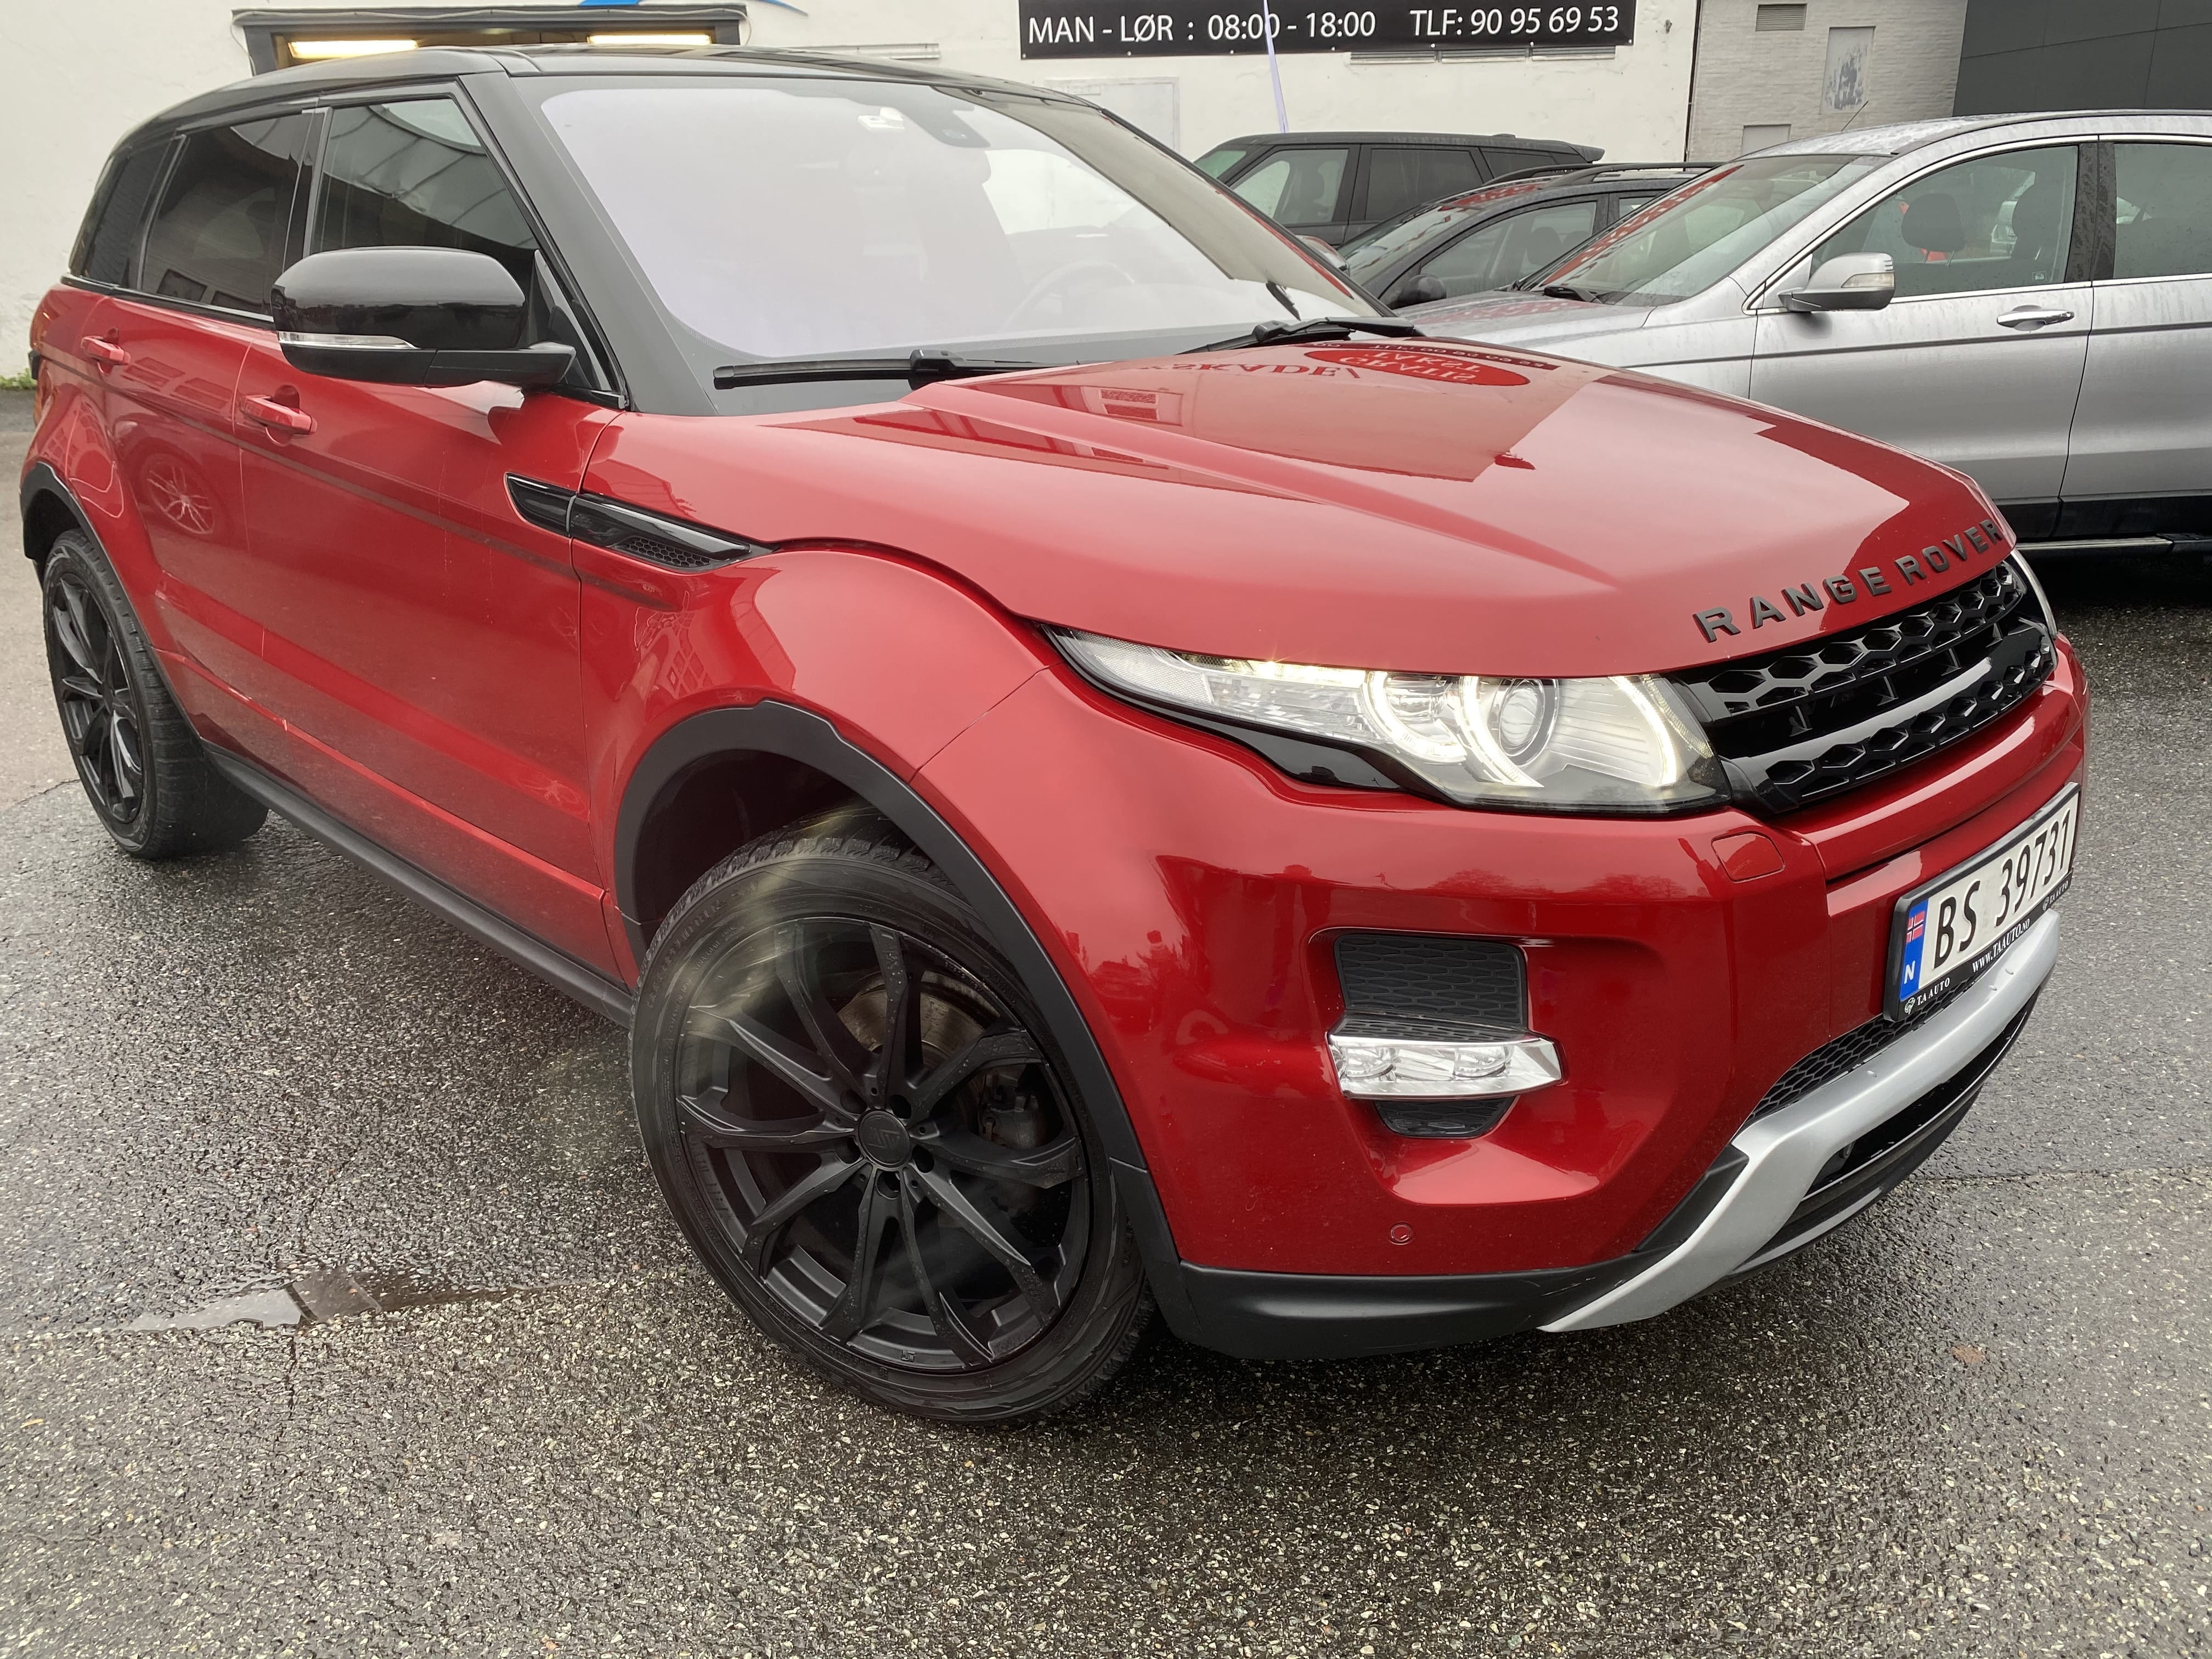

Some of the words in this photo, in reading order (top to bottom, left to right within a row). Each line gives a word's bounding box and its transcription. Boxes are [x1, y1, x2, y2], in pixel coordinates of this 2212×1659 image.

[1029, 16, 1094, 43] MAN
[1120, 14, 1173, 42] LØR
[1207, 13, 1280, 40] 08:00
[1306, 11, 1376, 38] 18:00
[1409, 9, 1463, 36] TLF:
[1470, 8, 1503, 35] 90
[1510, 8, 1542, 35] 95
[1548, 7, 1582, 33] 69
[1587, 5, 1619, 32] 53
[1692, 566, 1892, 643] RANGE
[1894, 518, 2005, 586] ROVER
[1933, 880, 1981, 970] BS
[1994, 808, 2070, 927] 39731
[1904, 960, 1916, 985] N
[1928, 977, 1950, 999] AUTO
